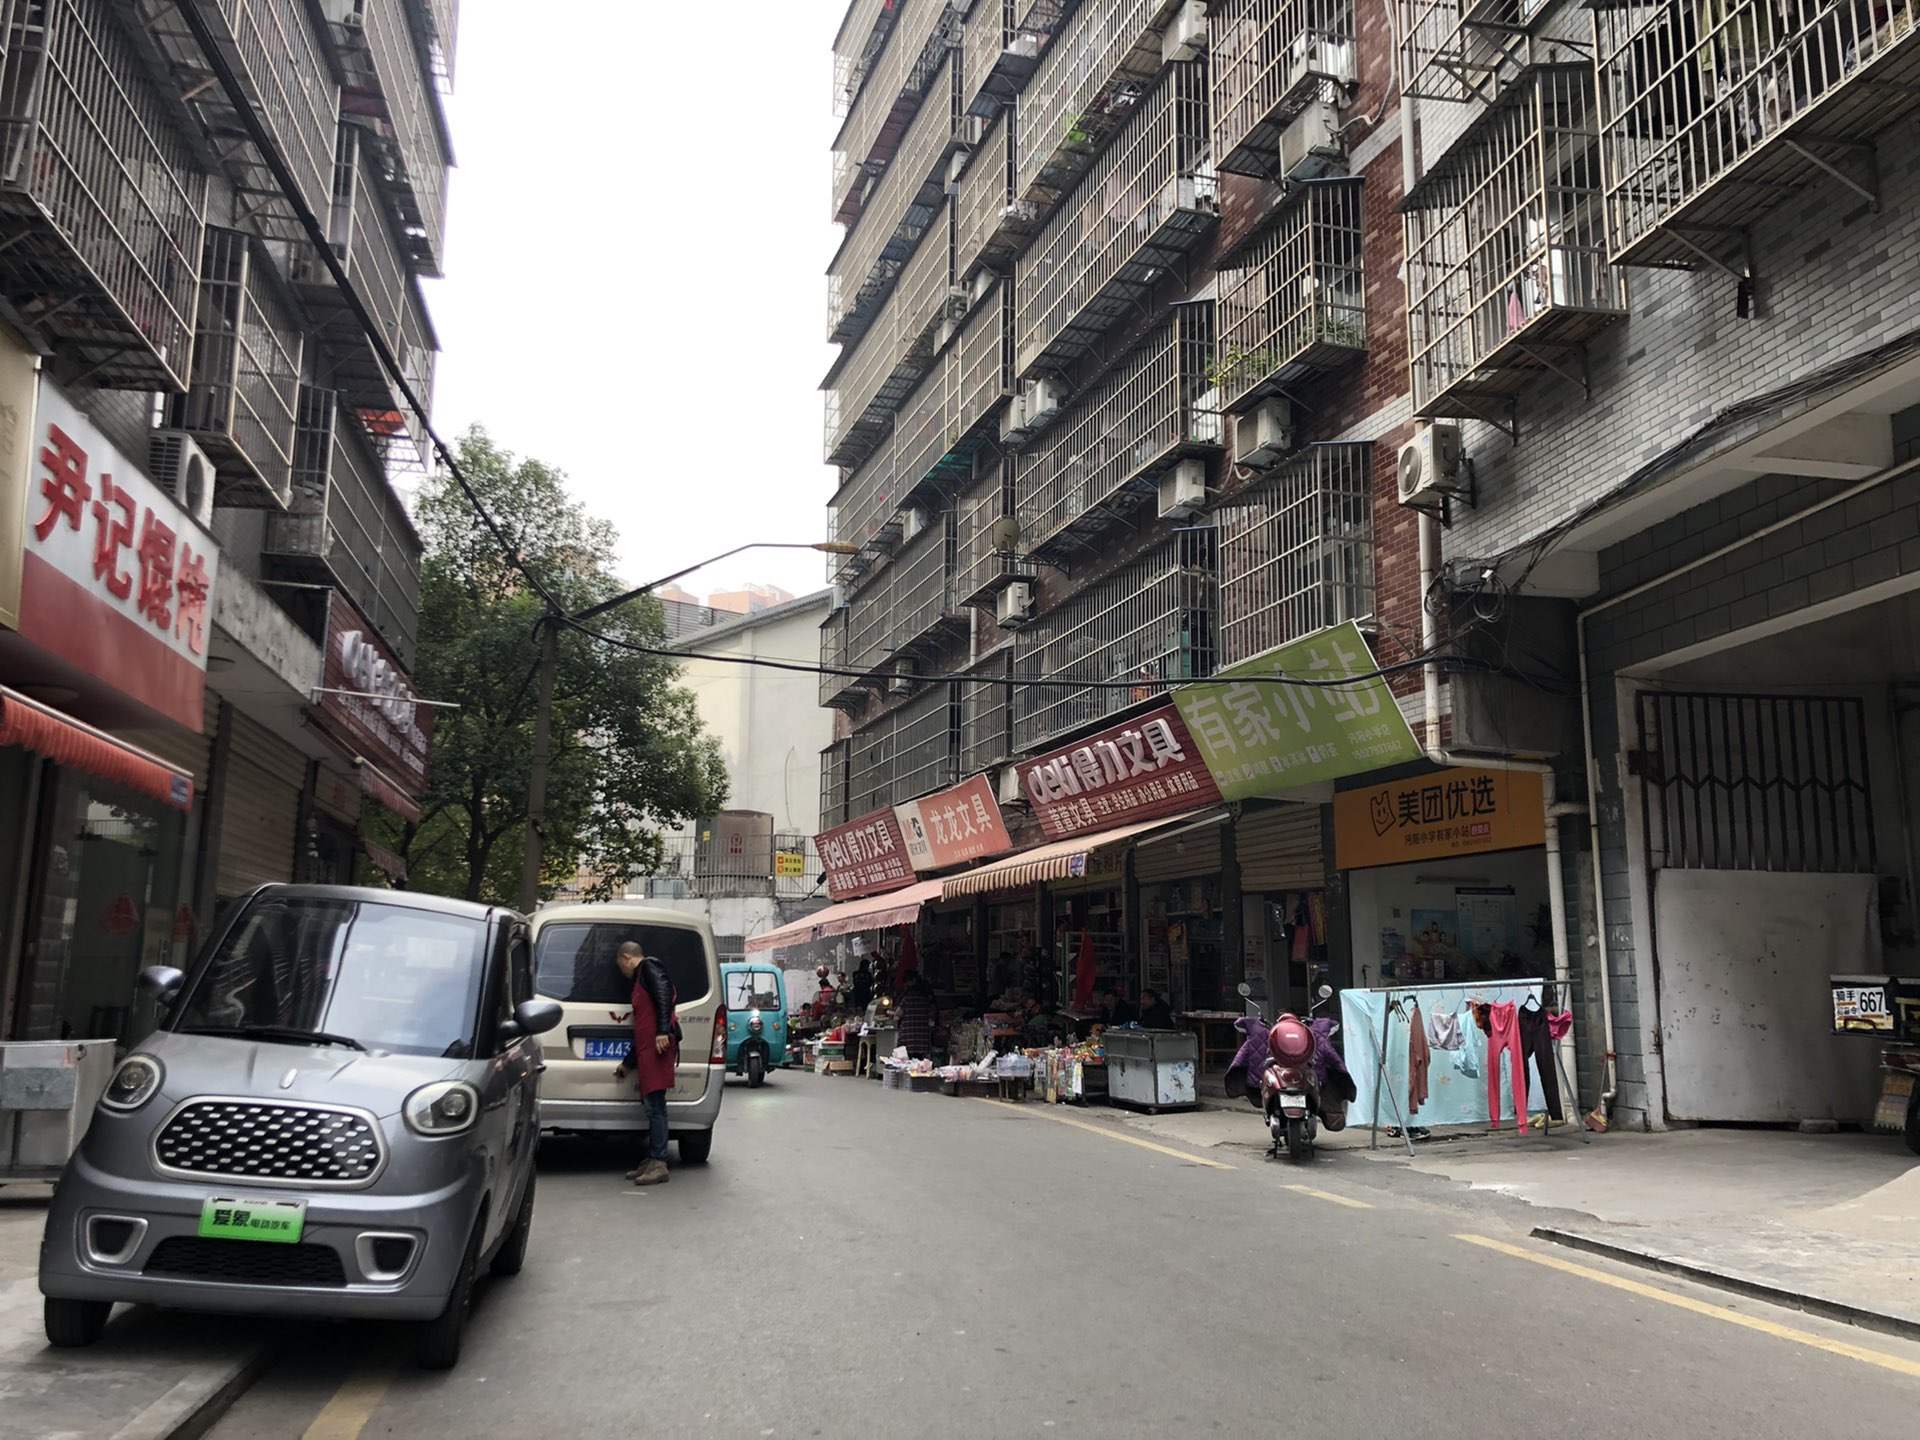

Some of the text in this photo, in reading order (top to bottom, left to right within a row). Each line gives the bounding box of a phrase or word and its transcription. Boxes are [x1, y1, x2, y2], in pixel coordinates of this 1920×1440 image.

[1182, 640, 1382, 761] 有家小站
[1071, 718, 1186, 791] 得力文具
[930, 793, 993, 845] 龙龙文具
[1398, 775, 1496, 828] 美团优选
[823, 820, 896, 870] deli 得力文具
[1860, 991, 1884, 1012] 667
[250, 1218, 291, 1230] 电动汽车
